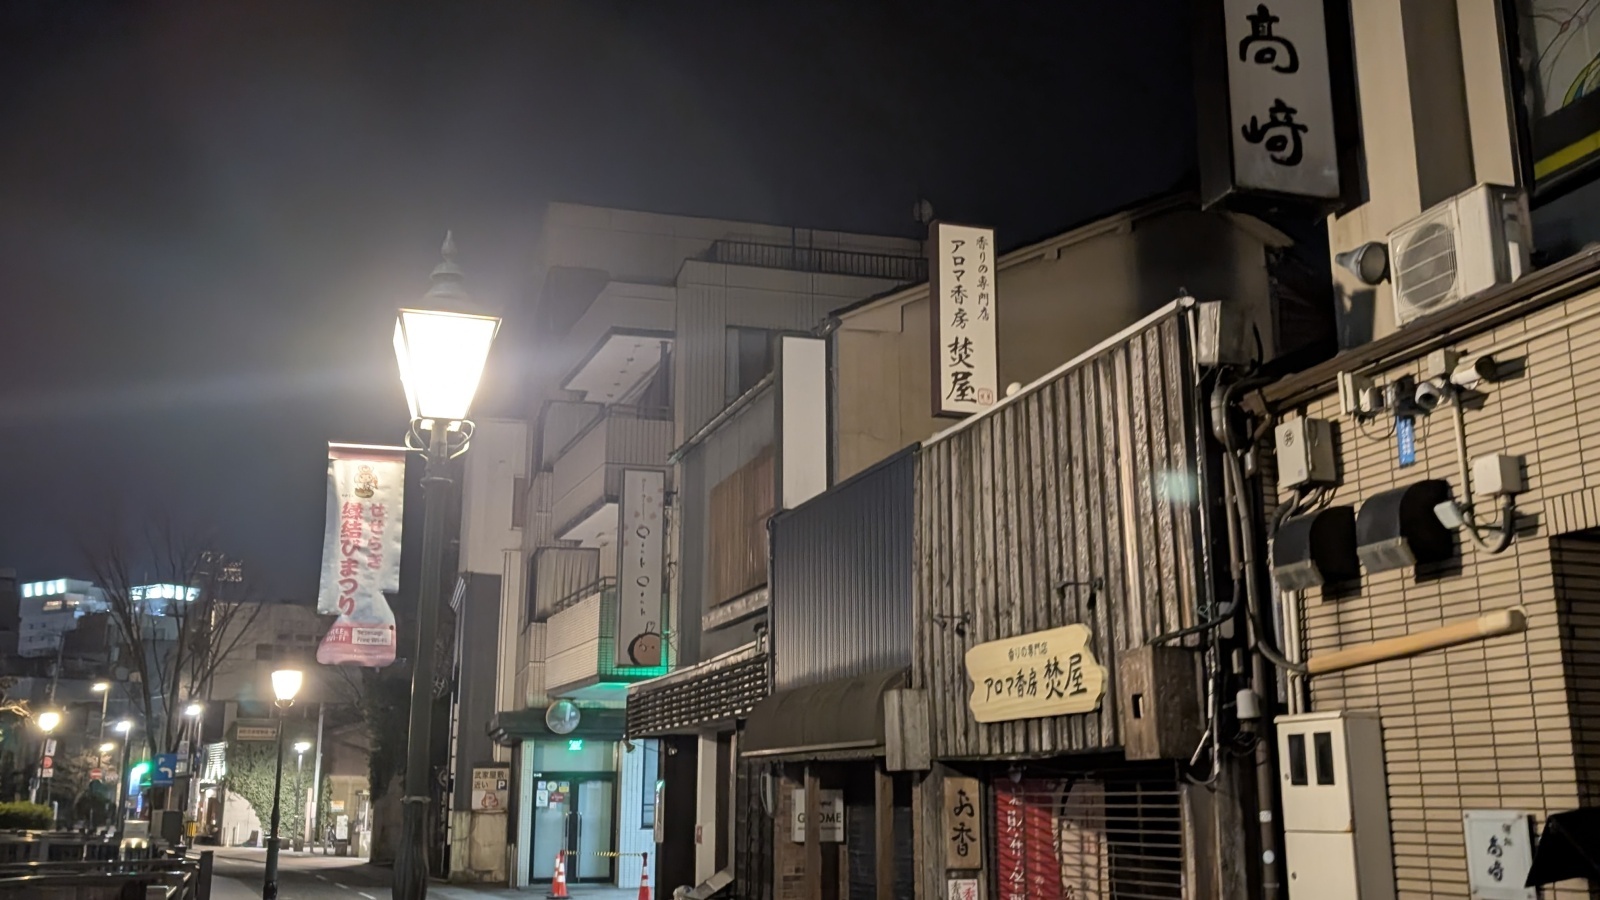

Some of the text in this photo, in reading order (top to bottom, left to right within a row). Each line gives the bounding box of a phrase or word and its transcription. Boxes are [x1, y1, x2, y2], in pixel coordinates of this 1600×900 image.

[976, 236, 990, 321] 香りの専門店
[946, 240, 977, 404] アロマ香房 焚屋
[338, 501, 364, 617] 縁結びまつり
[367, 503, 385, 570] せせらぎ
[984, 653, 1087, 703] アロマ香房 焚屋
[797, 812, 842, 823] GOME
[951, 788, 977, 857] お香
